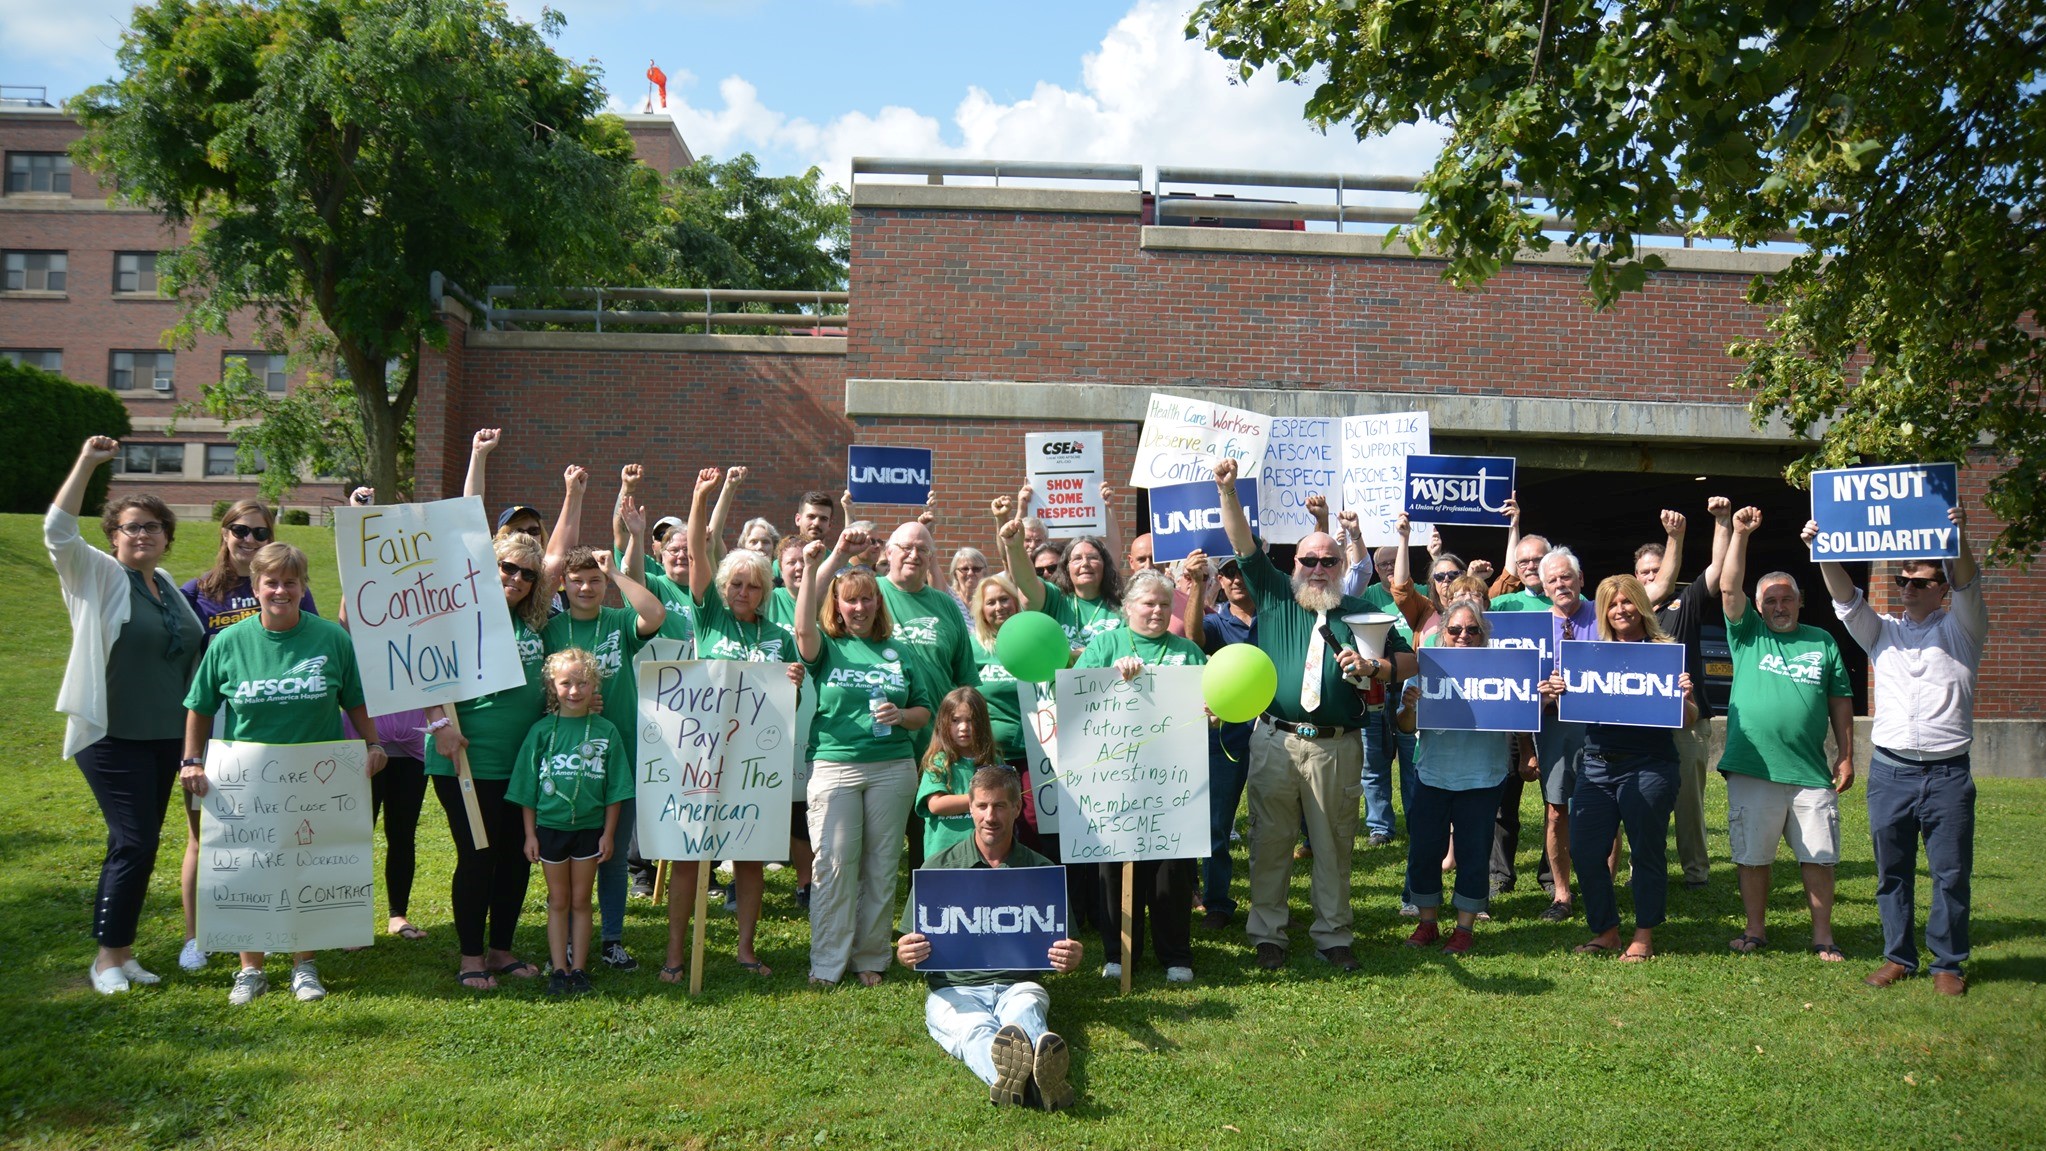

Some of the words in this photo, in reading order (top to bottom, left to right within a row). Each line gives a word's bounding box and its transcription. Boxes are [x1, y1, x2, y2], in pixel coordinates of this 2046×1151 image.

[1150, 400, 1180, 421] Health
[1184, 406, 1207, 425] Care
[1212, 409, 1260, 436] Workers
[1269, 419, 1330, 438] ESPECT
[1345, 420, 1389, 440] BCTGM
[1396, 417, 1418, 433] 116
[1042, 442, 1083, 455] CSEA
[1144, 426, 1201, 451] Deserve
[1206, 445, 1216, 455] a
[1223, 438, 1250, 460] fair
[1264, 444, 1331, 461] AFSCME
[1350, 442, 1416, 459] SUPPORTS
[850, 464, 930, 486] UNION.
[1046, 479, 1083, 490] SHOW
[1263, 466, 1336, 487] RESPECT
[1343, 467, 1388, 484] AFSCME
[1345, 486, 1402, 505] UNITED
[1410, 467, 1508, 512] nysut
[1833, 471, 1927, 502] NYSUT
[1048, 493, 1083, 504] SOME
[1435, 505, 1442, 513] of
[1036, 506, 1097, 519] RESPECT!
[1364, 505, 1391, 517] WE
[1867, 505, 1891, 526] IN
[360, 512, 432, 568] Fair
[1816, 527, 1952, 554] SOLIDARITY
[232, 596, 257, 610] I'm
[357, 558, 480, 628] Contract
[234, 675, 327, 698] AFSCME
[827, 667, 905, 687] AFSCME
[1074, 669, 1157, 696] Invest
[1421, 674, 1538, 702] UNION.
[1563, 668, 1681, 698] UNION.
[267, 693, 299, 703] America
[301, 691, 328, 701] Happen
[656, 666, 767, 726] Poverty
[1082, 718, 1144, 738] future
[1150, 716, 1173, 734] of
[678, 718, 740, 760] Pay?
[1096, 742, 1141, 764] ACH
[643, 757, 671, 784] Is
[681, 754, 724, 789] Not
[740, 756, 783, 790] The
[1066, 769, 1083, 787] By
[331, 794, 357, 812] TO
[660, 793, 759, 823] American
[1078, 792, 1164, 816] Members
[1172, 789, 1191, 808] of
[223, 825, 278, 845] HOME
[1087, 813, 1166, 835] AFSCME
[1134, 832, 1182, 856] 3124
[280, 888, 291, 906] A
[297, 883, 374, 905] CONTRACT
[918, 904, 1065, 936] UNION.
[264, 931, 299, 947] 3124
